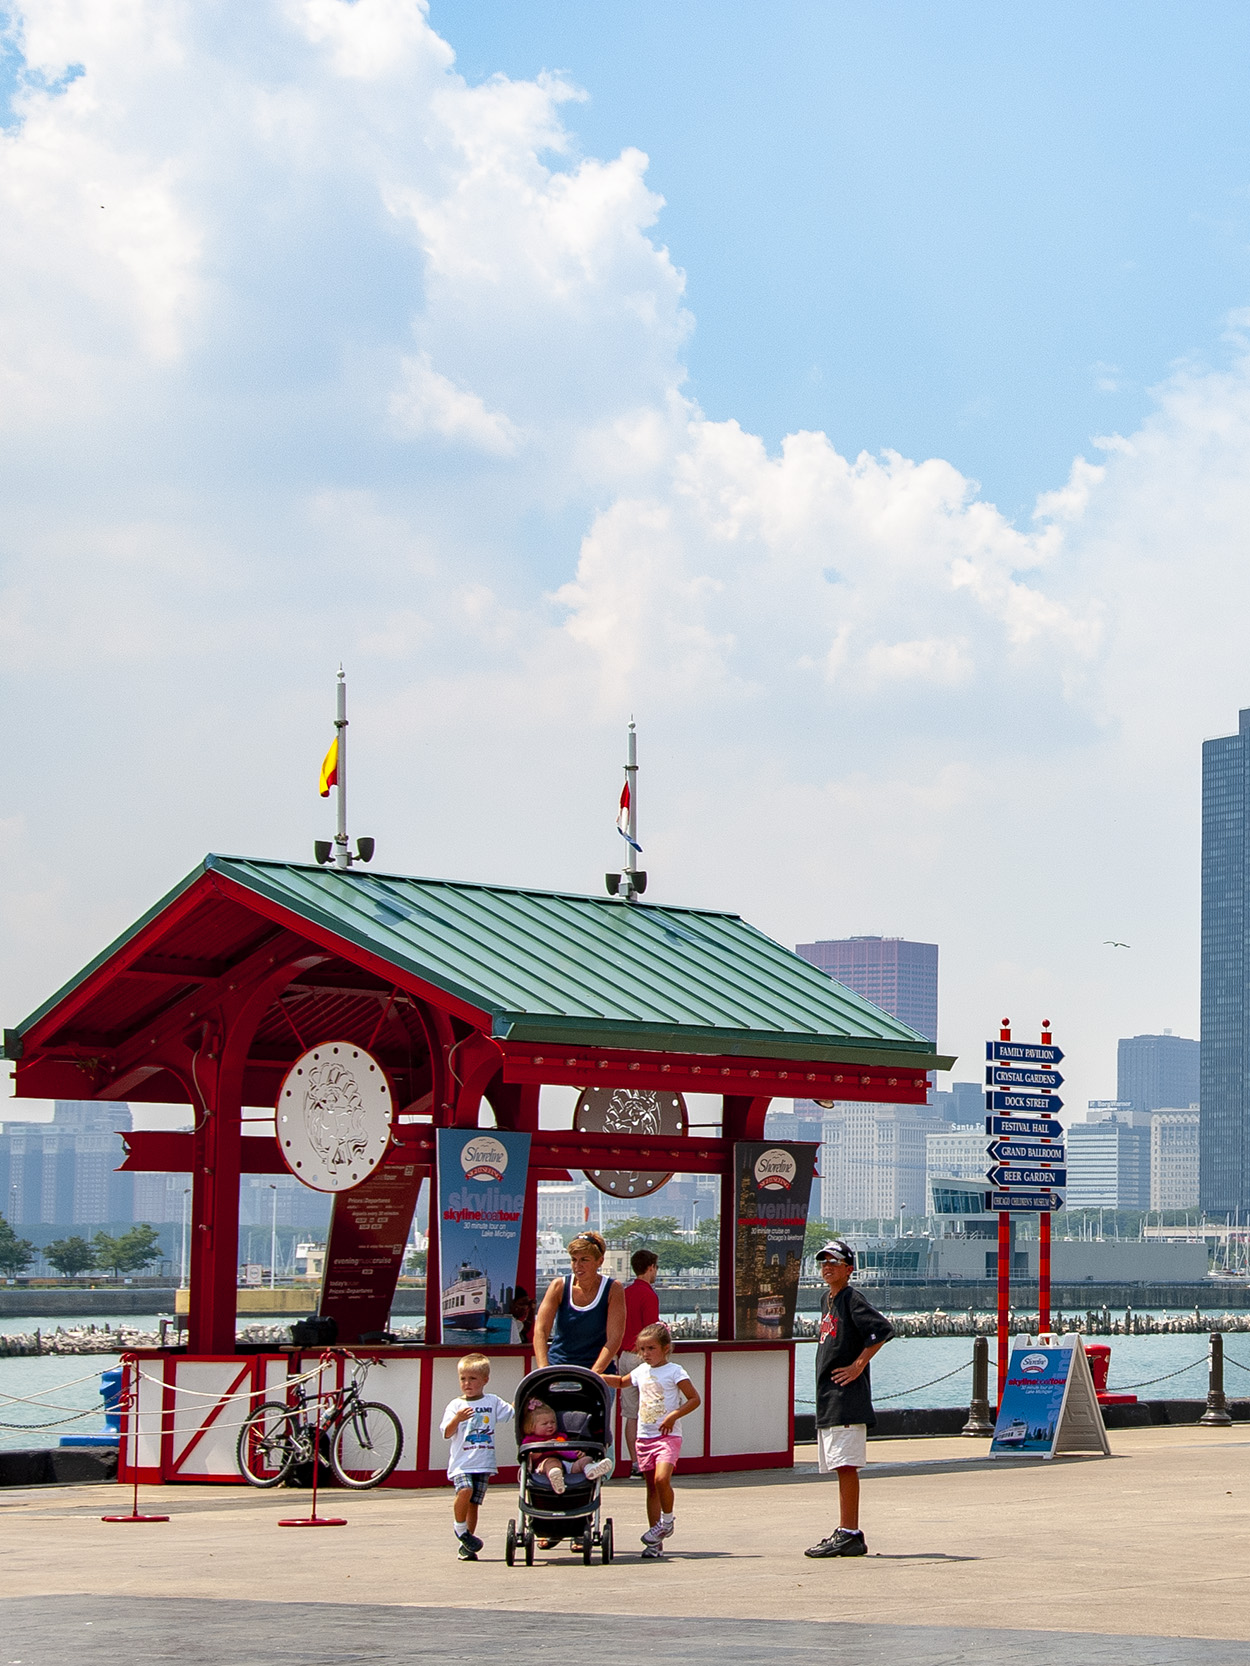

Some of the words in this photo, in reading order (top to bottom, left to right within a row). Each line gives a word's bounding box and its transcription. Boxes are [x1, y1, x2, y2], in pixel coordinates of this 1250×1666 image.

[1000, 1047, 1024, 1057] FAMILY
[1025, 1049, 1054, 1059] PAVILION
[996, 1071, 1024, 1082] CRYSTAL
[1025, 1073, 1056, 1084] GARDENS
[1005, 1096, 1024, 1107] DOCK
[1026, 1098, 1049, 1108] STREET
[951, 1122, 974, 1131] Santa
[1001, 1121, 1030, 1132] FESTIVAL
[1032, 1123, 1049, 1133] HALL
[465, 1146, 504, 1163] Shoreline
[1001, 1147, 1026, 1157] GRAND
[1028, 1148, 1062, 1158] BALLROOM
[758, 1159, 793, 1173] Shoreline
[1004, 1171, 1021, 1181] BEER
[1024, 1172, 1055, 1182] GARDEN
[448, 1186, 524, 1210] skyline
[463, 1222, 471, 1230] 30
[471, 1222, 488, 1230] minute
[489, 1222, 499, 1230] tour
[481, 1230, 494, 1238] Lake
[494, 1230, 516, 1239] Michigan
